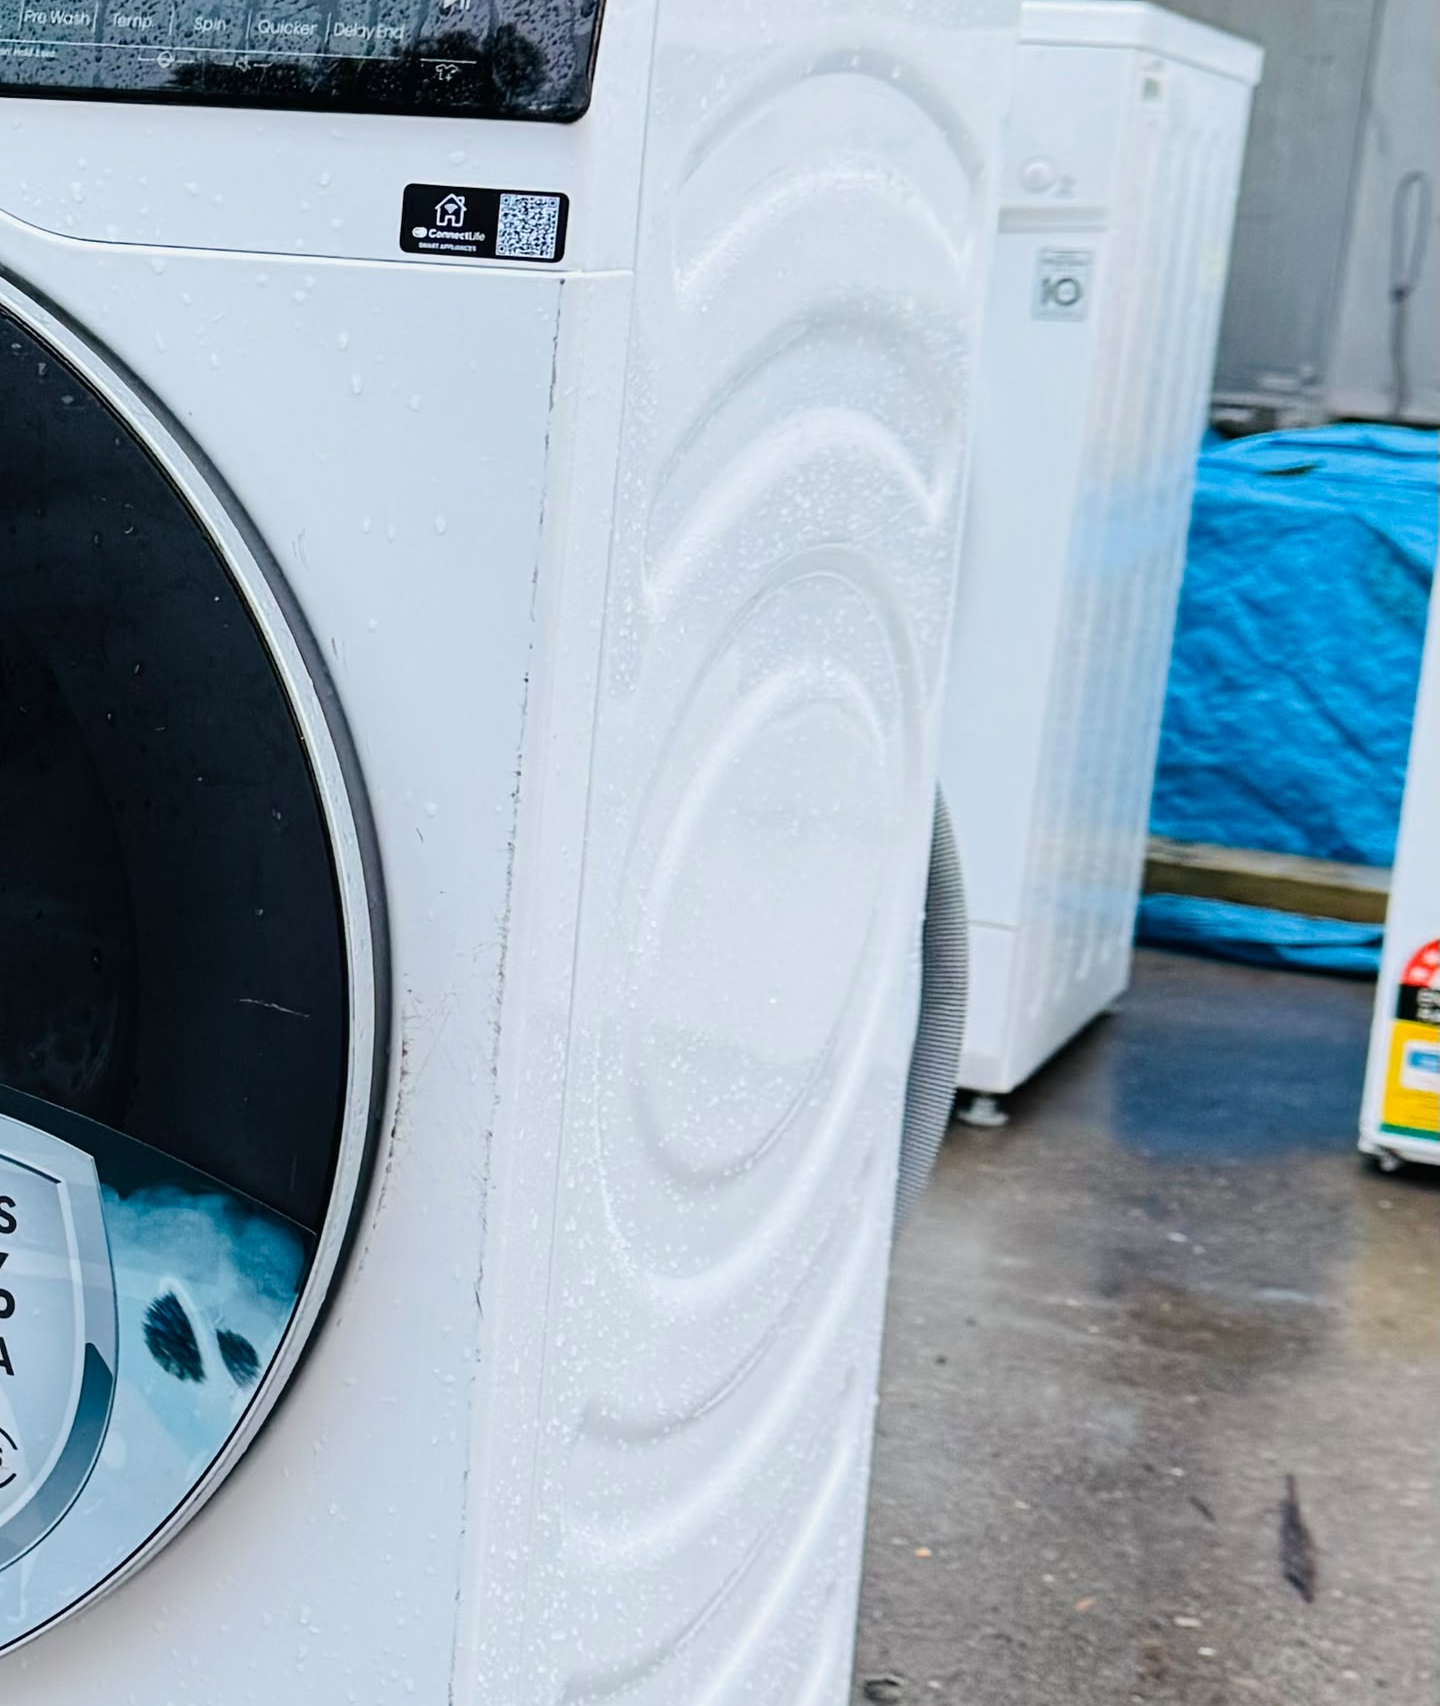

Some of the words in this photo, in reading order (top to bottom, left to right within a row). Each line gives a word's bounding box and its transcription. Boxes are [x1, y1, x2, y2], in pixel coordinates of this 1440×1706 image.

[23, 9, 46, 25] Pre
[49, 9, 91, 26] Wash
[193, 16, 228, 33] Spin
[258, 19, 319, 36] Quicker
[333, 21, 375, 41] Delay
[376, 23, 405, 40] End
[428, 228, 486, 242] ConnectLife
[418, 242, 440, 250] SMART
[440, 243, 477, 253] APPLIANCES
